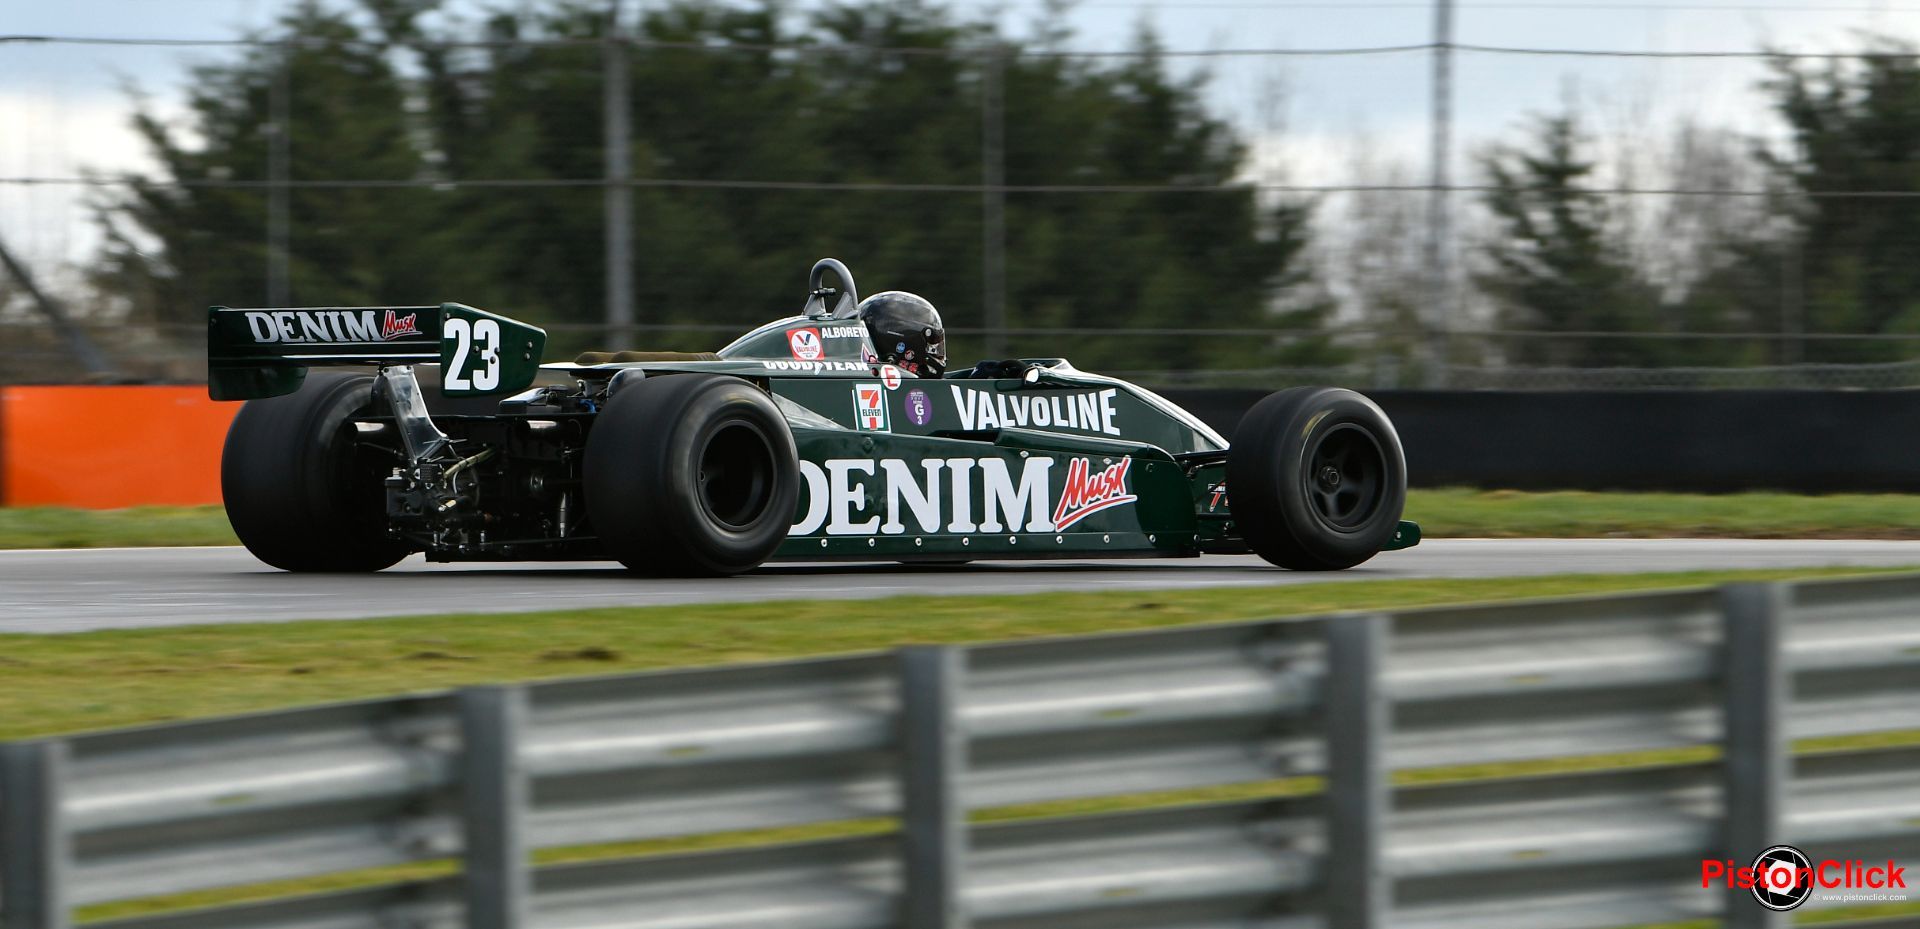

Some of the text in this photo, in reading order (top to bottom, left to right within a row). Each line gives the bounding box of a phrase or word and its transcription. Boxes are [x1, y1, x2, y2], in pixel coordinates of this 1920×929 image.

[245, 310, 385, 342] DENIM
[821, 327, 869, 339] ALBORETO
[444, 318, 501, 391] 23
[884, 367, 898, 387] E
[861, 389, 880, 430] 7
[914, 403, 925, 416] G
[917, 415, 923, 425] 3
[951, 384, 1121, 436] VALVOLINE
[787, 457, 1056, 536] DENIM
